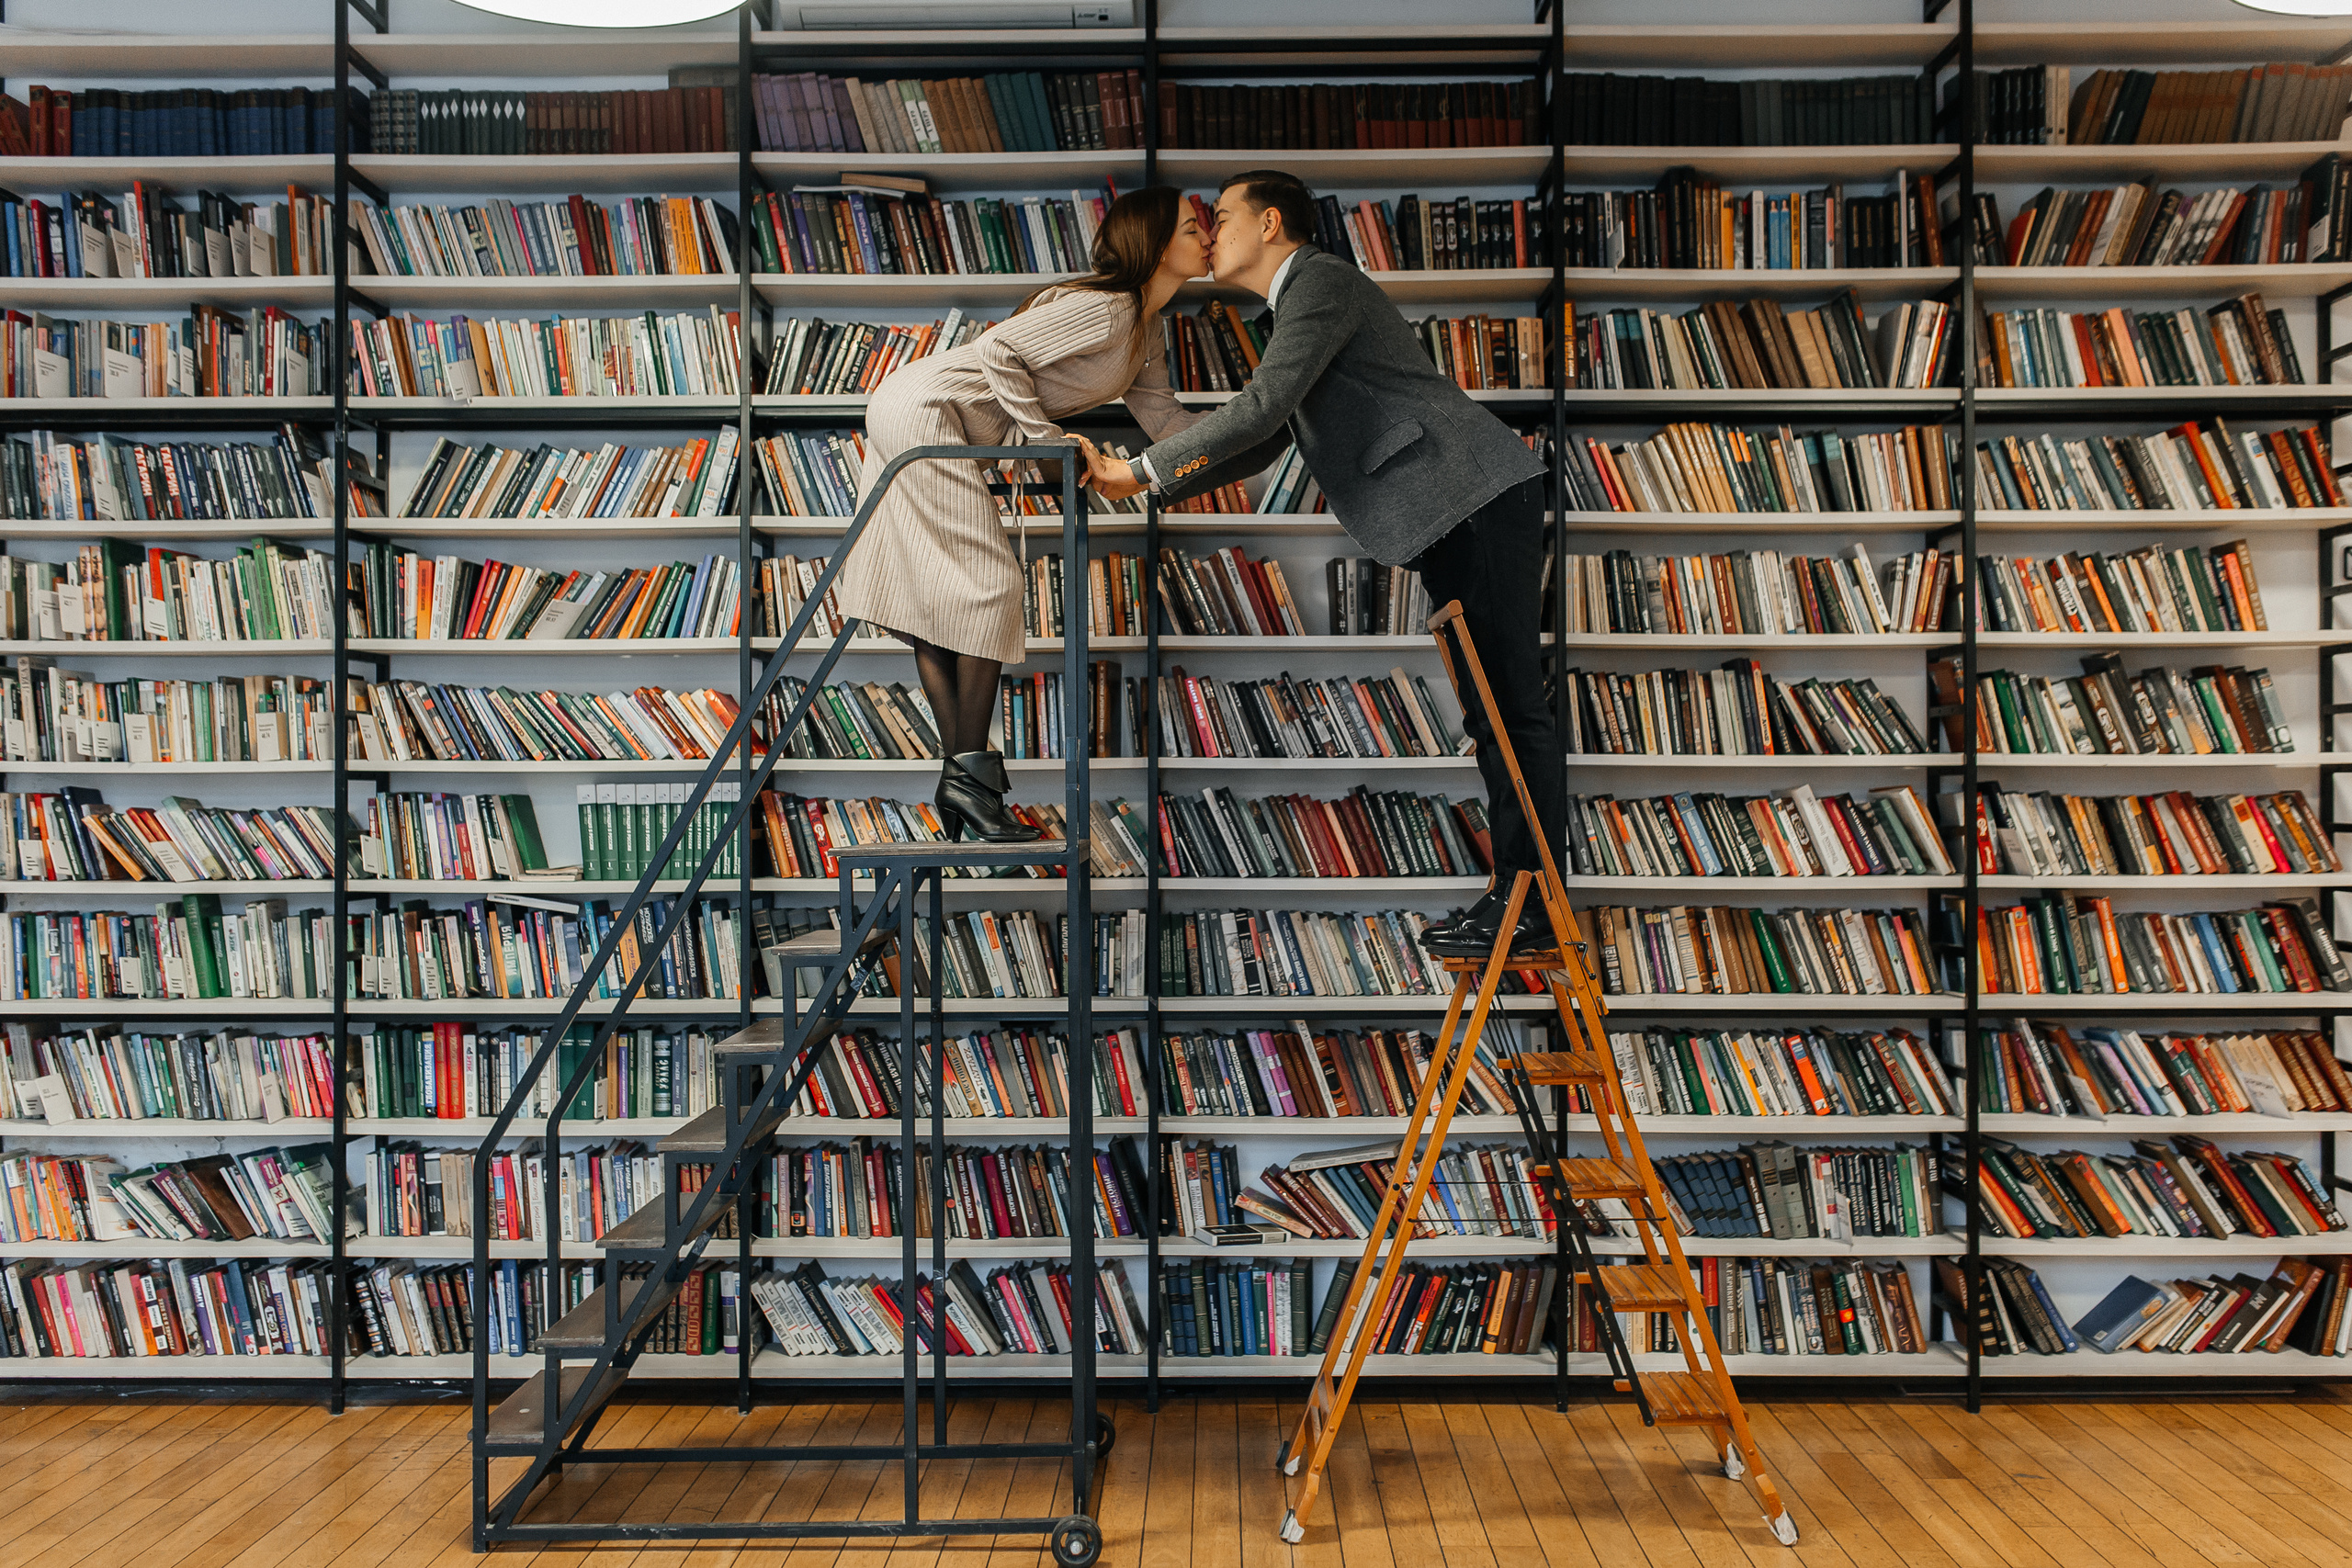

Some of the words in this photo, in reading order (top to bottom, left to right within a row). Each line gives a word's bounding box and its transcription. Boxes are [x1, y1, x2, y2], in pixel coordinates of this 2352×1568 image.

[635, 357, 644, 394] ПЕДИАТРИЯ
[135, 447, 152, 497] ГАГАРИН
[160, 447, 179, 497] ГАГАРИН
[643, 907, 654, 943] ЛЕКСИКОН
[500, 925, 518, 976] ИМПЕРИЯ
[137, 1051, 151, 1102] УРИНОТЕРАПИЯ
[309, 1039, 325, 1082] АВИЦЕННА
[424, 1043, 434, 1105] ГЛОБАЛИЗАЦИЯ
[660, 1059, 669, 1089] УЭЛЛС
[953, 1056, 974, 1102] СВЕТОНИЙ
[963, 1047, 982, 1088] ПЛУТАРХ
[531, 1177, 539, 1201] Быков
[823, 1163, 831, 1209] ДЕМОГРАФИЯ
[1102, 1173, 1122, 1217] КРЕСТОВЫЕ
[533, 1205, 542, 1236] Дмитрий
